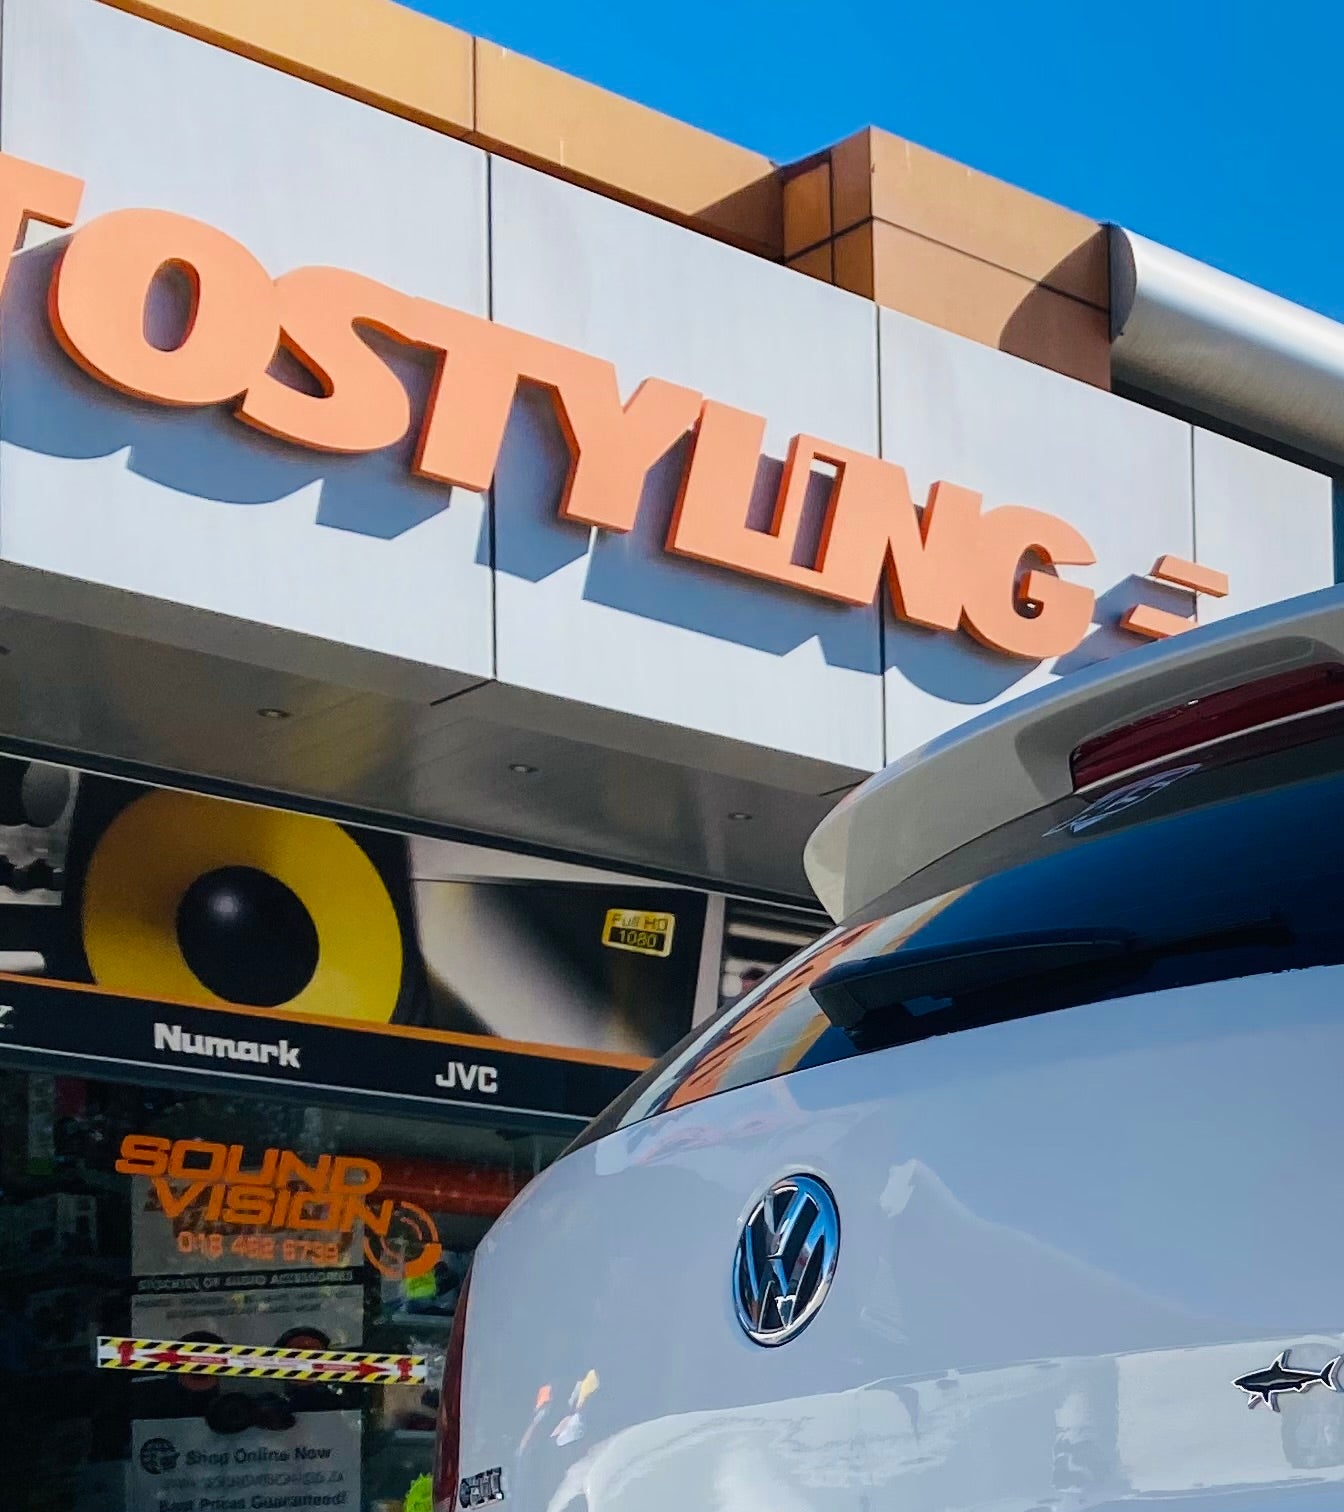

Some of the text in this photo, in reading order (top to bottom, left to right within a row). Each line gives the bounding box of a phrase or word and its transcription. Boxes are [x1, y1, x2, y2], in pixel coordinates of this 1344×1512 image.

[619, 929, 657, 948] 1080
[644, 915, 669, 931] HD
[153, 1022, 301, 1069] Numark
[435, 1061, 498, 1094] JVC
[115, 1134, 382, 1195] SOUND
[152, 1175, 393, 1237] VISION
